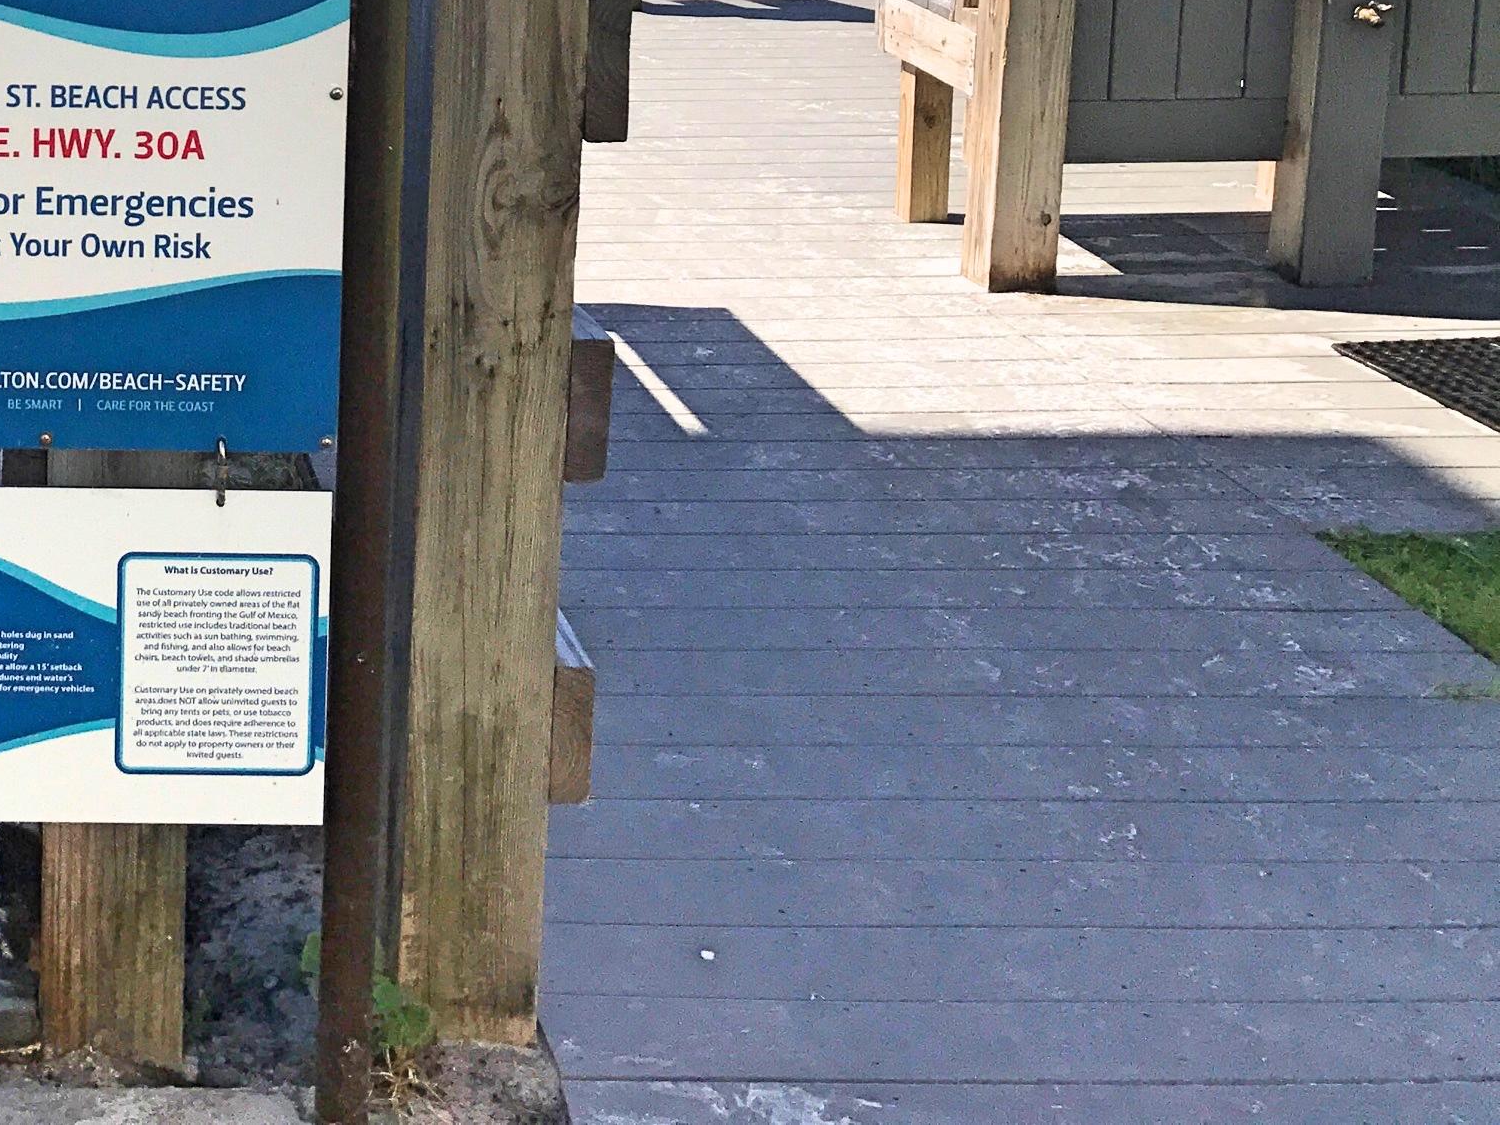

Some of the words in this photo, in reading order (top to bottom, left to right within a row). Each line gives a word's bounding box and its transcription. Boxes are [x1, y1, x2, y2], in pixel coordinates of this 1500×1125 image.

[6, 85, 40, 108] ST.
[51, 85, 138, 109] BEACH
[146, 86, 246, 111] ACCESS
[33, 129, 121, 159] HWY.
[134, 131, 204, 160] 30A
[36, 187, 254, 226] Emergencies
[10, 233, 72, 257] Your
[80, 233, 144, 258] Own
[154, 233, 211, 259] Risk
[8, 399, 21, 409] BE
[25, 399, 63, 410] SMART
[97, 400, 126, 410] CARE
[129, 400, 151, 411] FOR
[154, 401, 175, 411] THE
[178, 401, 214, 412] COAST
[164, 566, 189, 574] What
[200, 566, 250, 577] Customary
[252, 567, 273, 575] Use?
[25, 631, 42, 640] dug
[54, 631, 74, 639] sand
[13, 685, 59, 693] emergency
